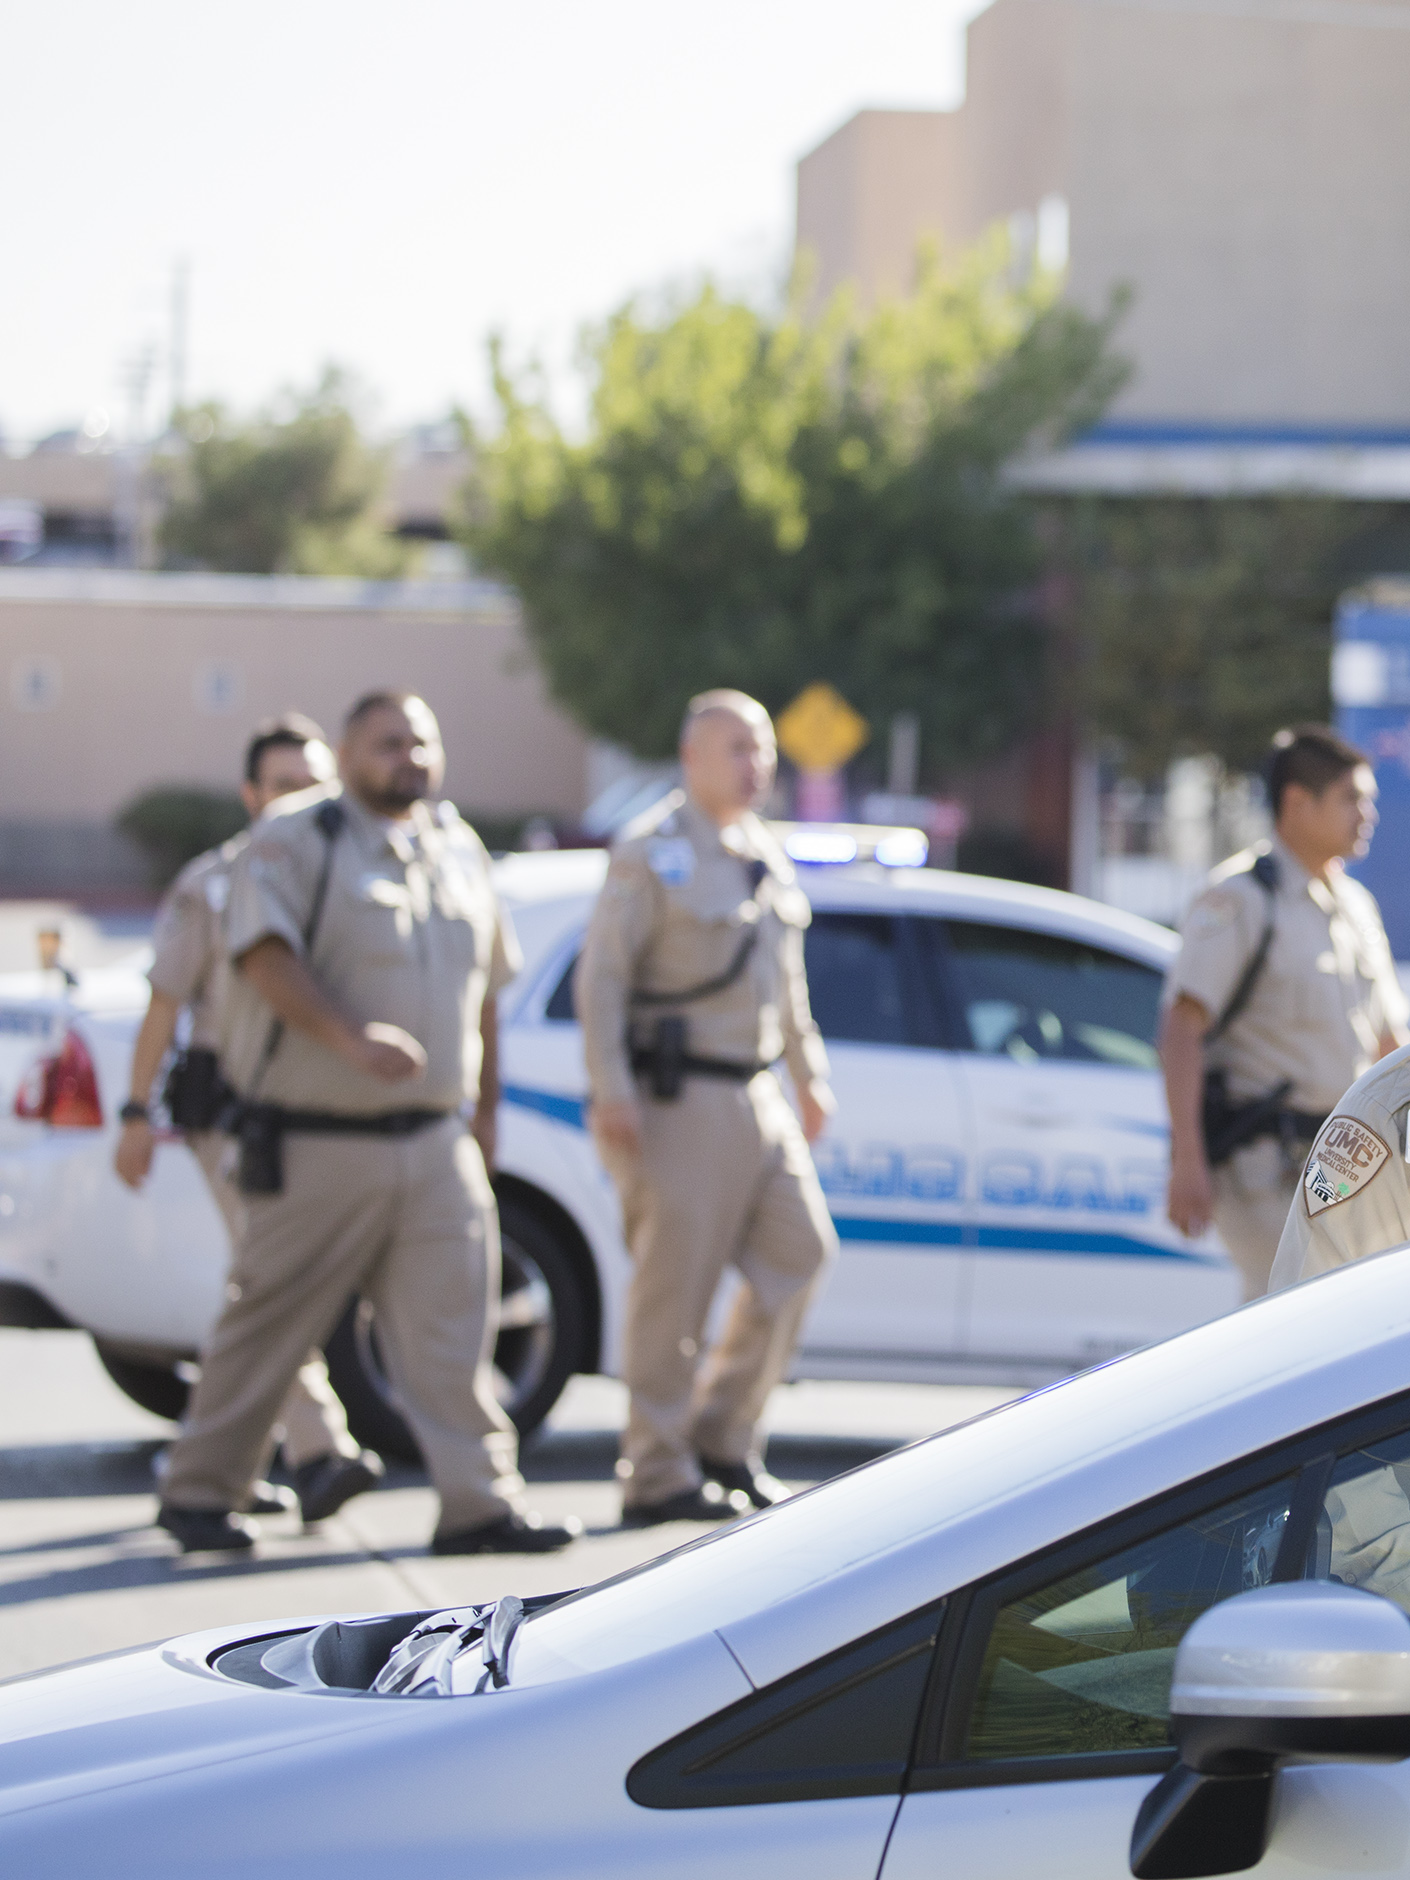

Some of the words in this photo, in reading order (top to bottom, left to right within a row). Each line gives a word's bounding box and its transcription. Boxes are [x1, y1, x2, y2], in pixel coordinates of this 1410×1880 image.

[1324, 1129, 1374, 1168] UMC
[1353, 1128, 1383, 1158] SAFETY
[1316, 1151, 1336, 1170] MEDICAL
[1334, 1163, 1360, 1182] CENTER
[1324, 1147, 1357, 1170] UNIVERSITY
